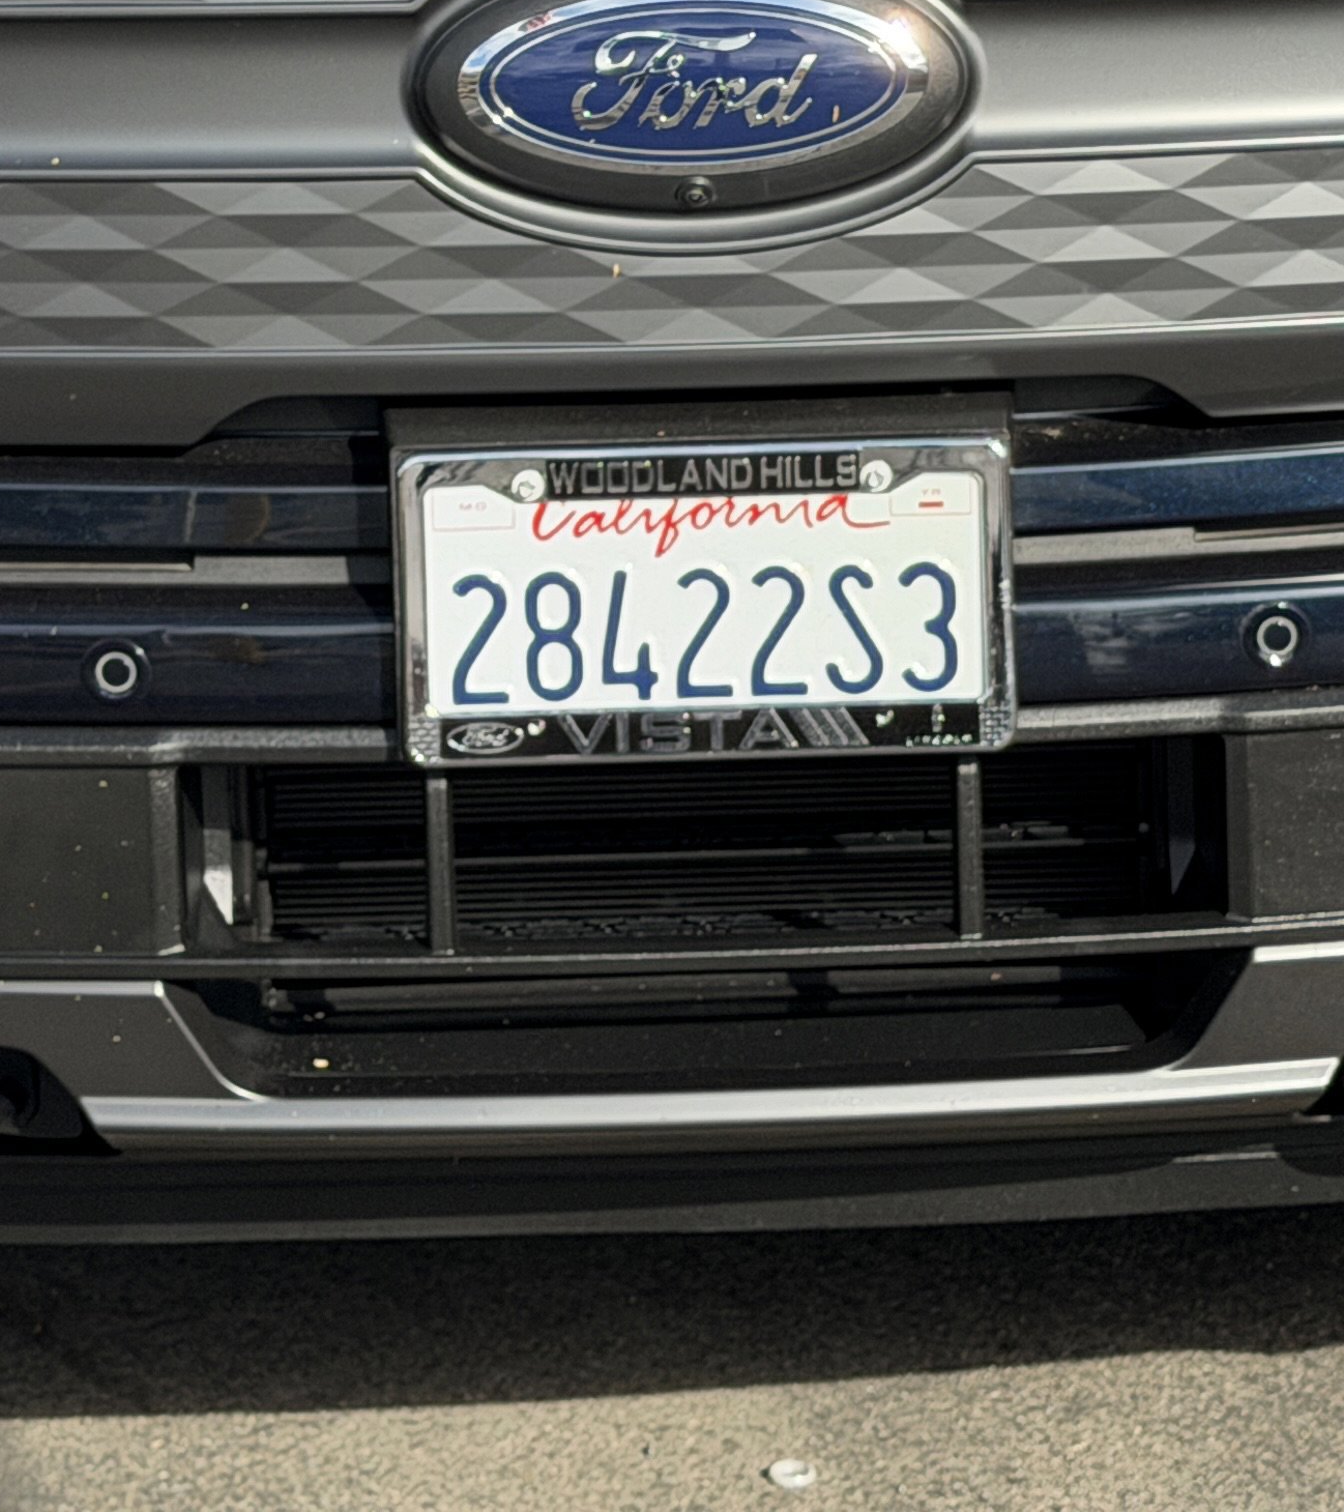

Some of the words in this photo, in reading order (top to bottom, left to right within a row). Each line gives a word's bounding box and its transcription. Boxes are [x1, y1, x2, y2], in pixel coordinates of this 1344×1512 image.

[570, 29, 819, 131] Ford
[548, 455, 754, 495] WOODLAND
[761, 452, 858, 490] HILLS
[531, 492, 891, 558] California
[451, 561, 959, 706] 28422S3
[562, 707, 799, 755] VISTA
